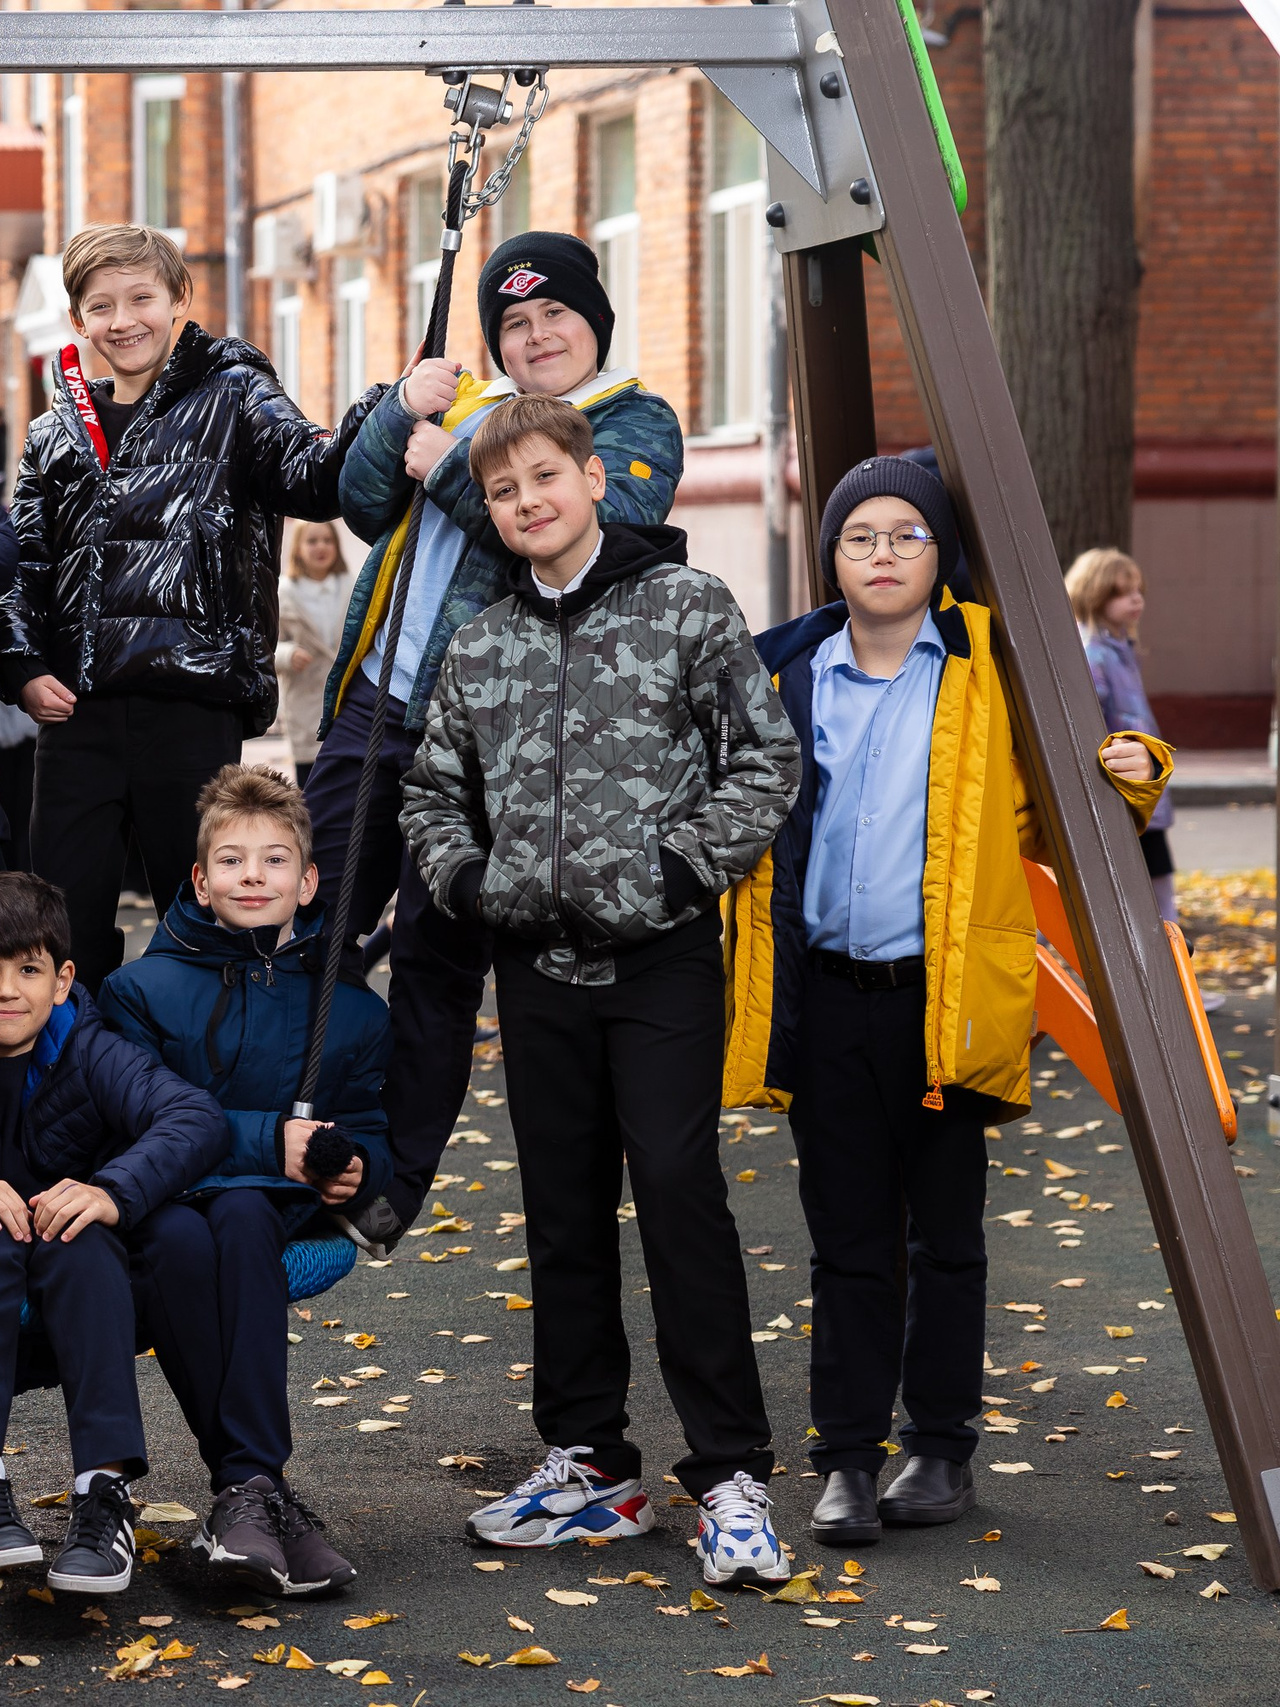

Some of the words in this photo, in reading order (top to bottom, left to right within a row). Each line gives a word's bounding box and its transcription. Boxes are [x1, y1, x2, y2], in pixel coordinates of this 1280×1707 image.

[64, 366, 99, 426] ALASKA
[721, 724, 729, 740] STAY
[720, 741, 729, 757] TRUE
